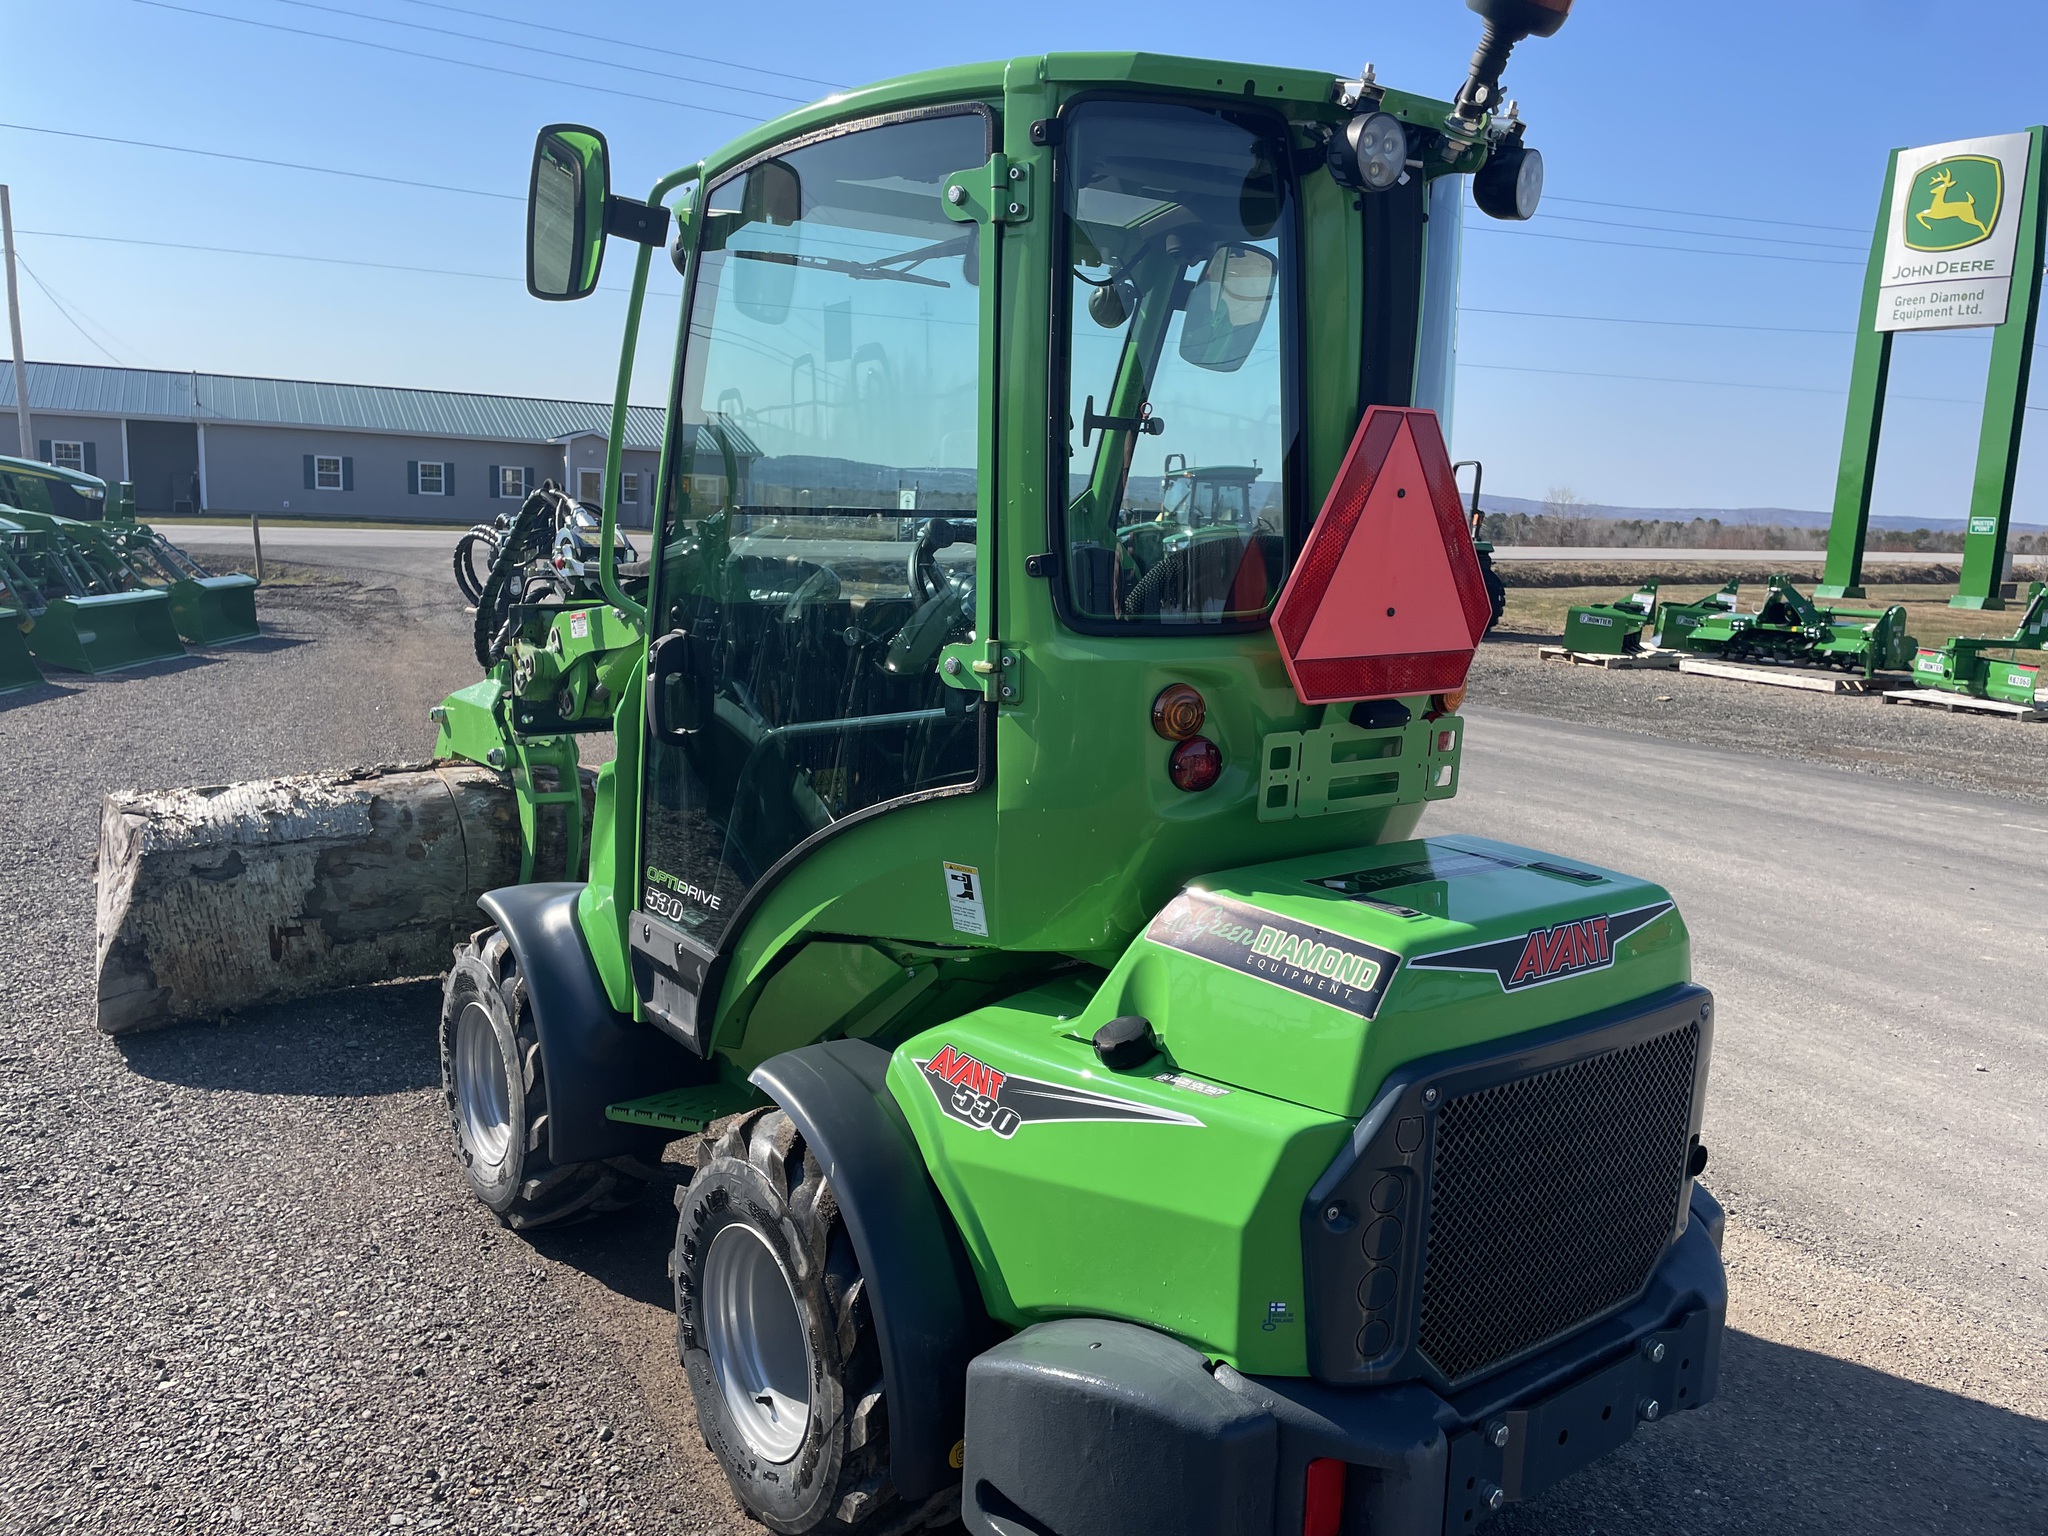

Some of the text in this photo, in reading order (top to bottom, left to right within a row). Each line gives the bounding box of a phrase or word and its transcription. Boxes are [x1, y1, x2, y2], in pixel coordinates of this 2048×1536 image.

[1892, 259, 1995, 279] JOHN DEERE
[1892, 304, 1983, 321] Equipment Ltd.
[1894, 289, 1985, 307] Green Diamond
[645, 886, 684, 922] 530
[646, 865, 722, 910] OPTIDRIVE
[1192, 905, 1256, 945] Green
[1250, 924, 1381, 992] DIAMOND
[1508, 914, 1609, 985] AVANT
[1246, 954, 1354, 999] EQUIPMENT
[924, 1043, 1006, 1100] AVANT
[950, 1081, 1022, 1140] 530
